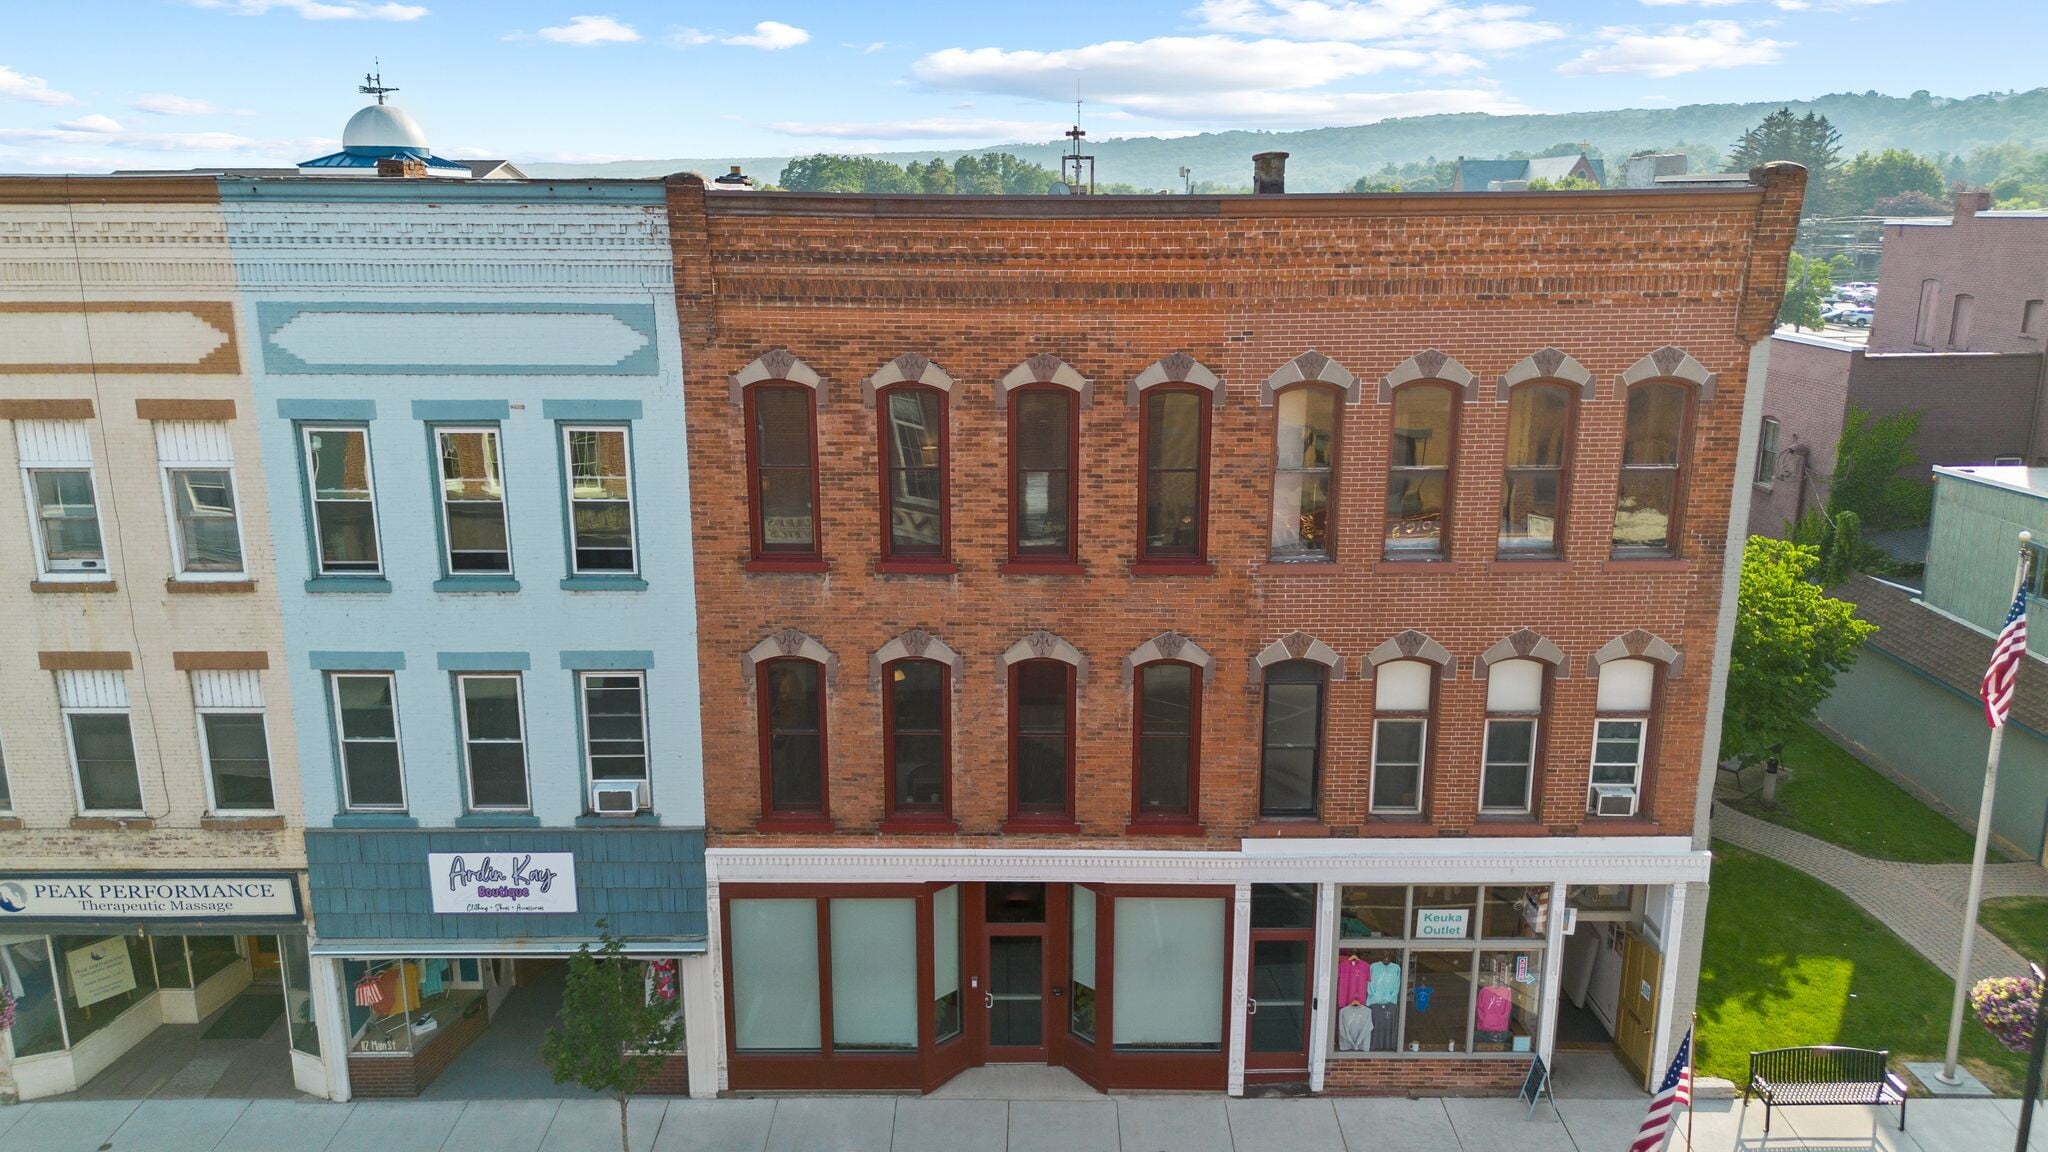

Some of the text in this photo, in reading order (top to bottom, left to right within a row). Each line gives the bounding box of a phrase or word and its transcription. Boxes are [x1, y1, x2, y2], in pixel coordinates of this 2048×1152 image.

[449, 855, 557, 893] Ardin Kay
[34, 884, 275, 899] PEAK PERFORMANCE
[478, 886, 530, 901] Boutique
[79, 900, 233, 913] Therapeutic Massage
[466, 903, 488, 912] Clothing
[1424, 913, 1462, 922] Keuka
[1423, 925, 1461, 935] Outlet
[371, 1040, 387, 1051] Main
[387, 1040, 397, 1050] St
